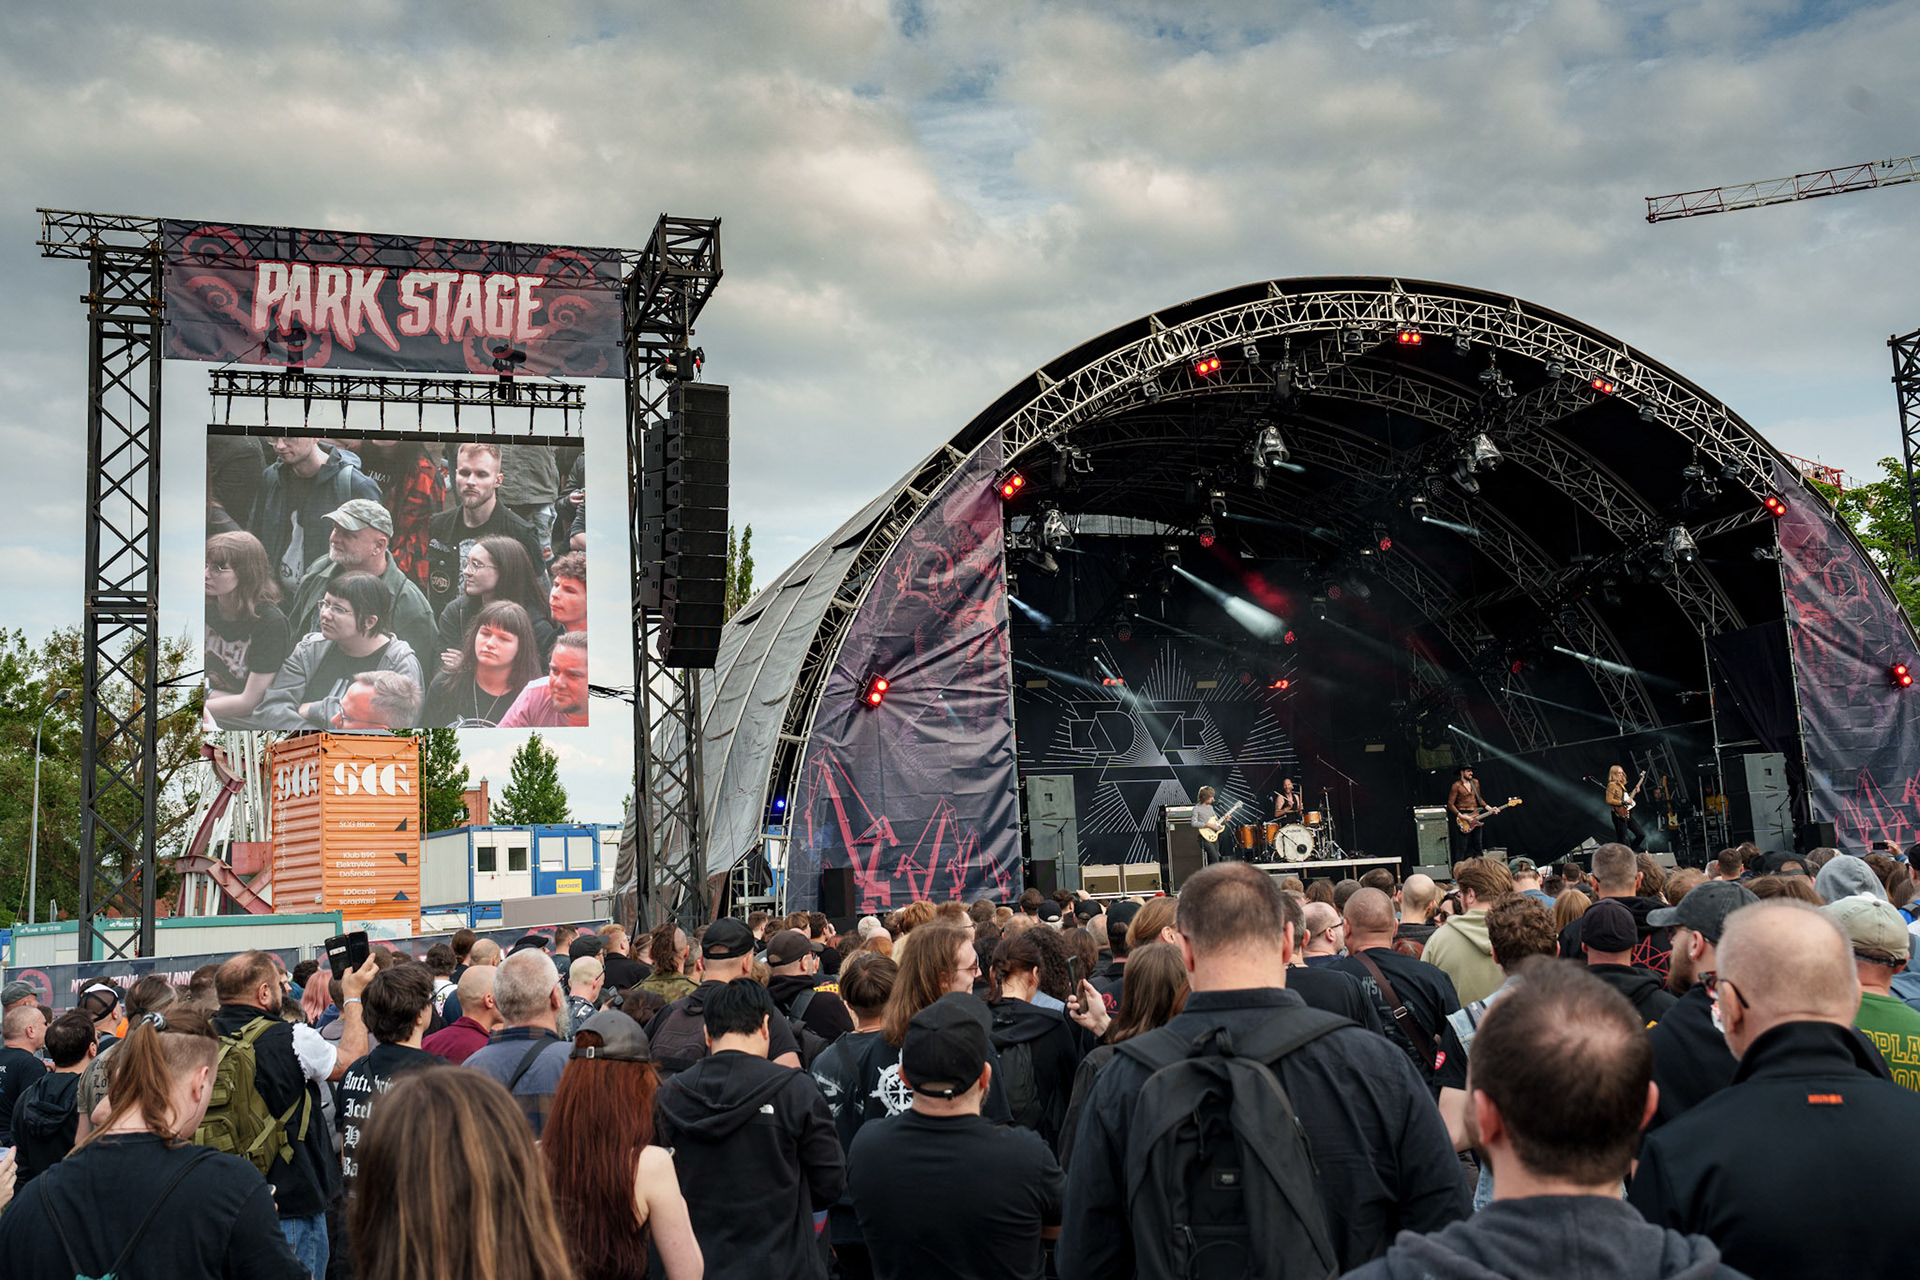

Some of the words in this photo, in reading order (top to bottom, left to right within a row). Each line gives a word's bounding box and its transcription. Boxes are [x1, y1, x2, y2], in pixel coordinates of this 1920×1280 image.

[253, 261, 399, 350] PARK
[398, 269, 545, 343] STAGE
[278, 762, 318, 800] SCG
[334, 763, 410, 796] SCG
[343, 851, 360, 859] Klub
[361, 851, 376, 859] B90
[336, 861, 376, 869] Elektryków
[339, 869, 376, 878] DoŚrodka
[339, 898, 377, 906] scrapYard
